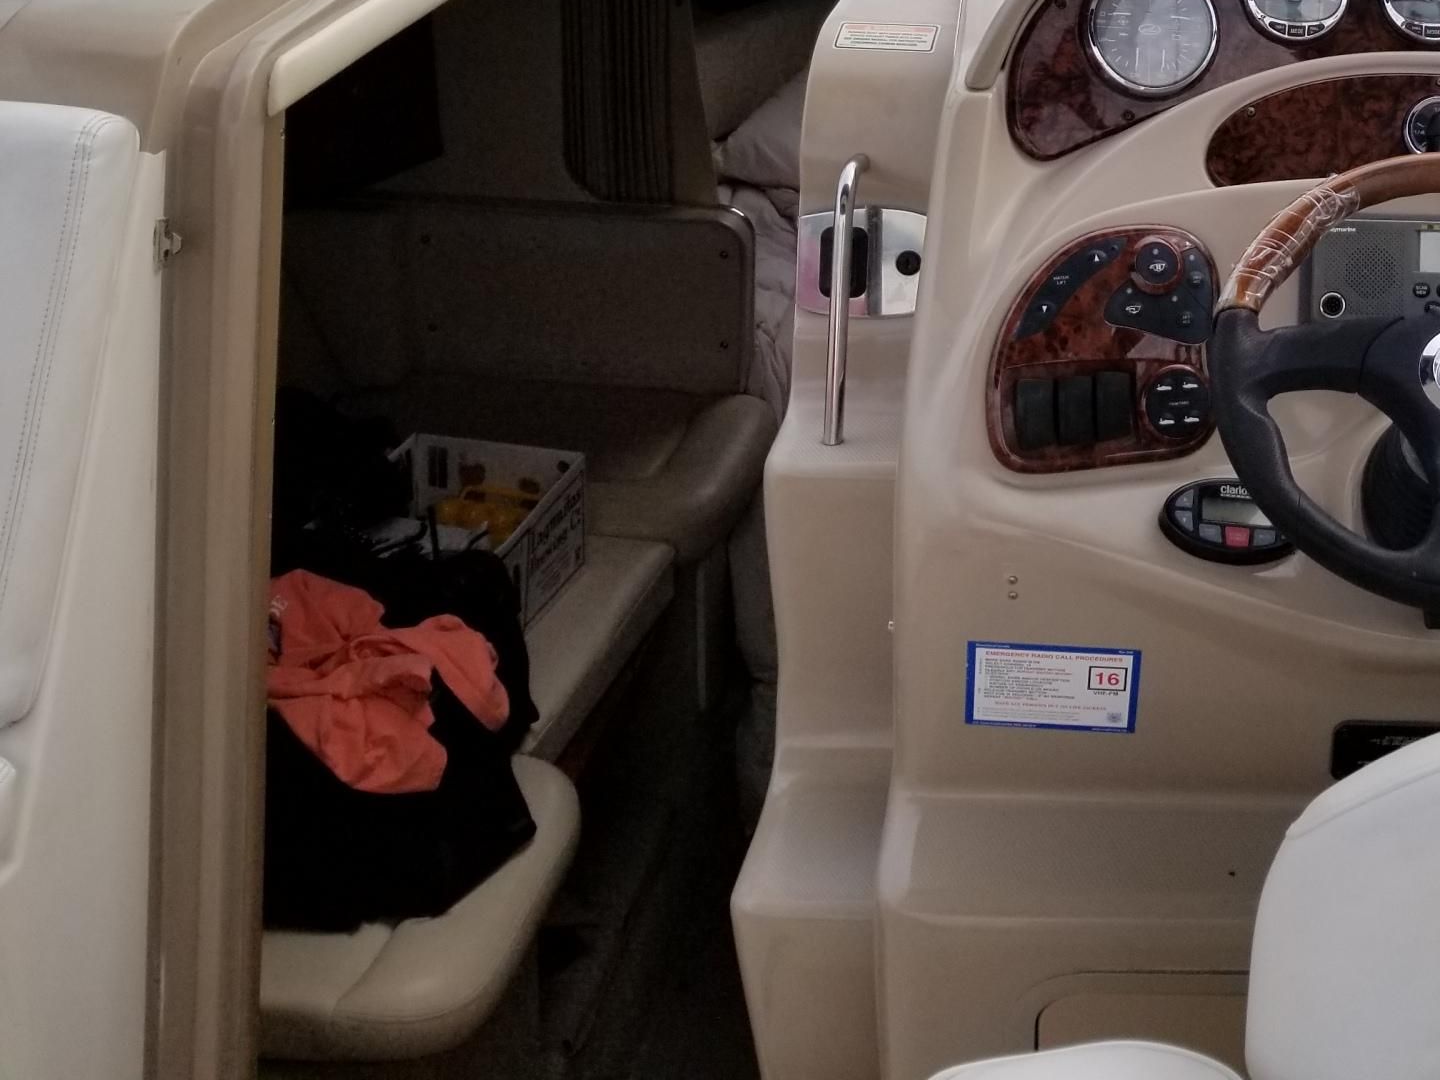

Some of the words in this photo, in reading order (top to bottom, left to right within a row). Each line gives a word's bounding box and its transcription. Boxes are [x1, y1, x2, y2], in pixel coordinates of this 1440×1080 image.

[1220, 485, 1250, 496] clario
[985, 650, 1030, 658] EMERGENCY
[1075, 655, 1123, 663] PROCEDURES
[1095, 672, 1120, 686] 16
